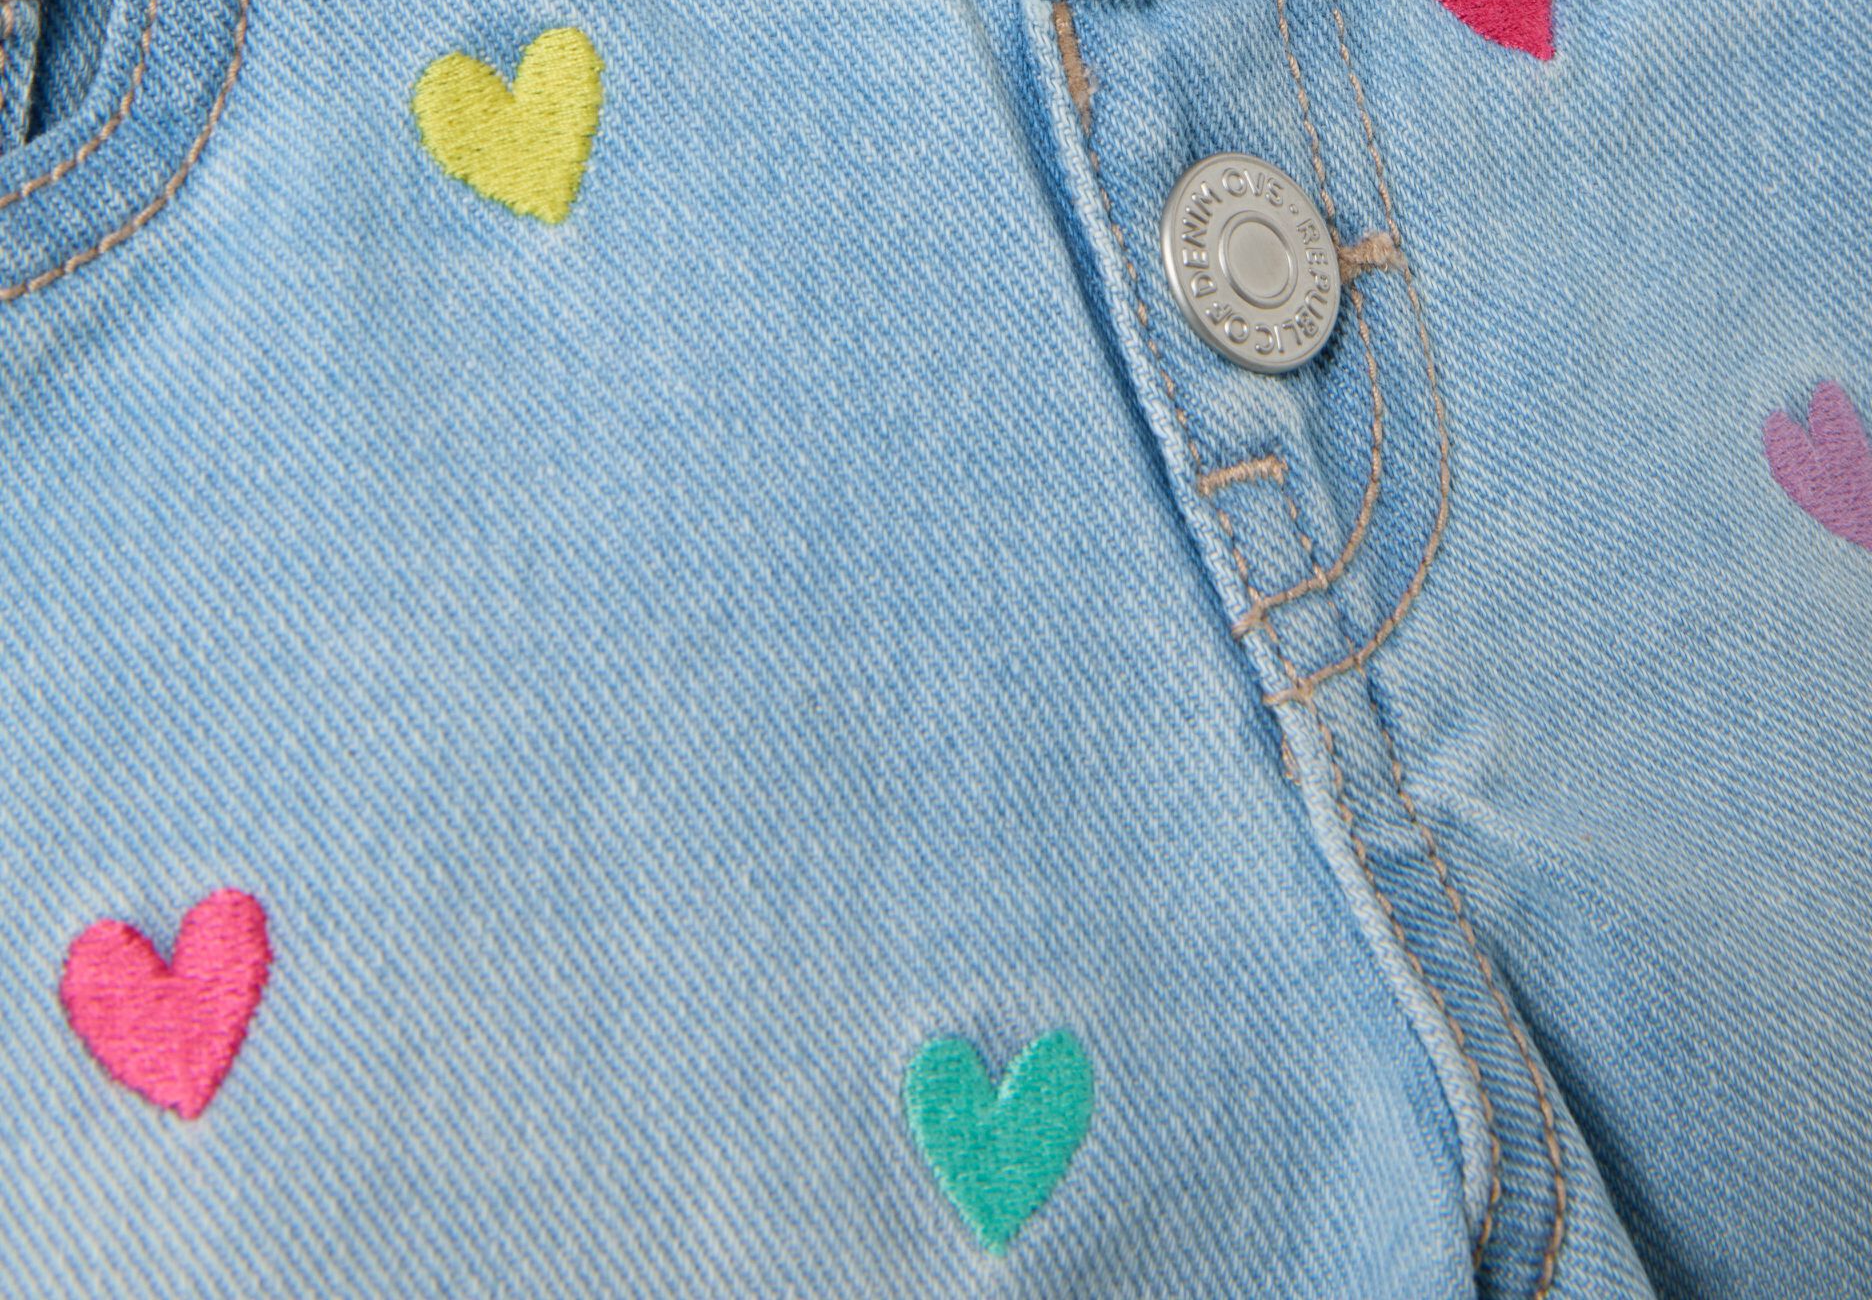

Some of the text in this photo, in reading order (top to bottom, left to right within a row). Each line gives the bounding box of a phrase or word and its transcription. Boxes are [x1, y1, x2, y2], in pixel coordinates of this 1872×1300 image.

[1181, 167, 1331, 355] OVS REPUBLIC OF DENIM
